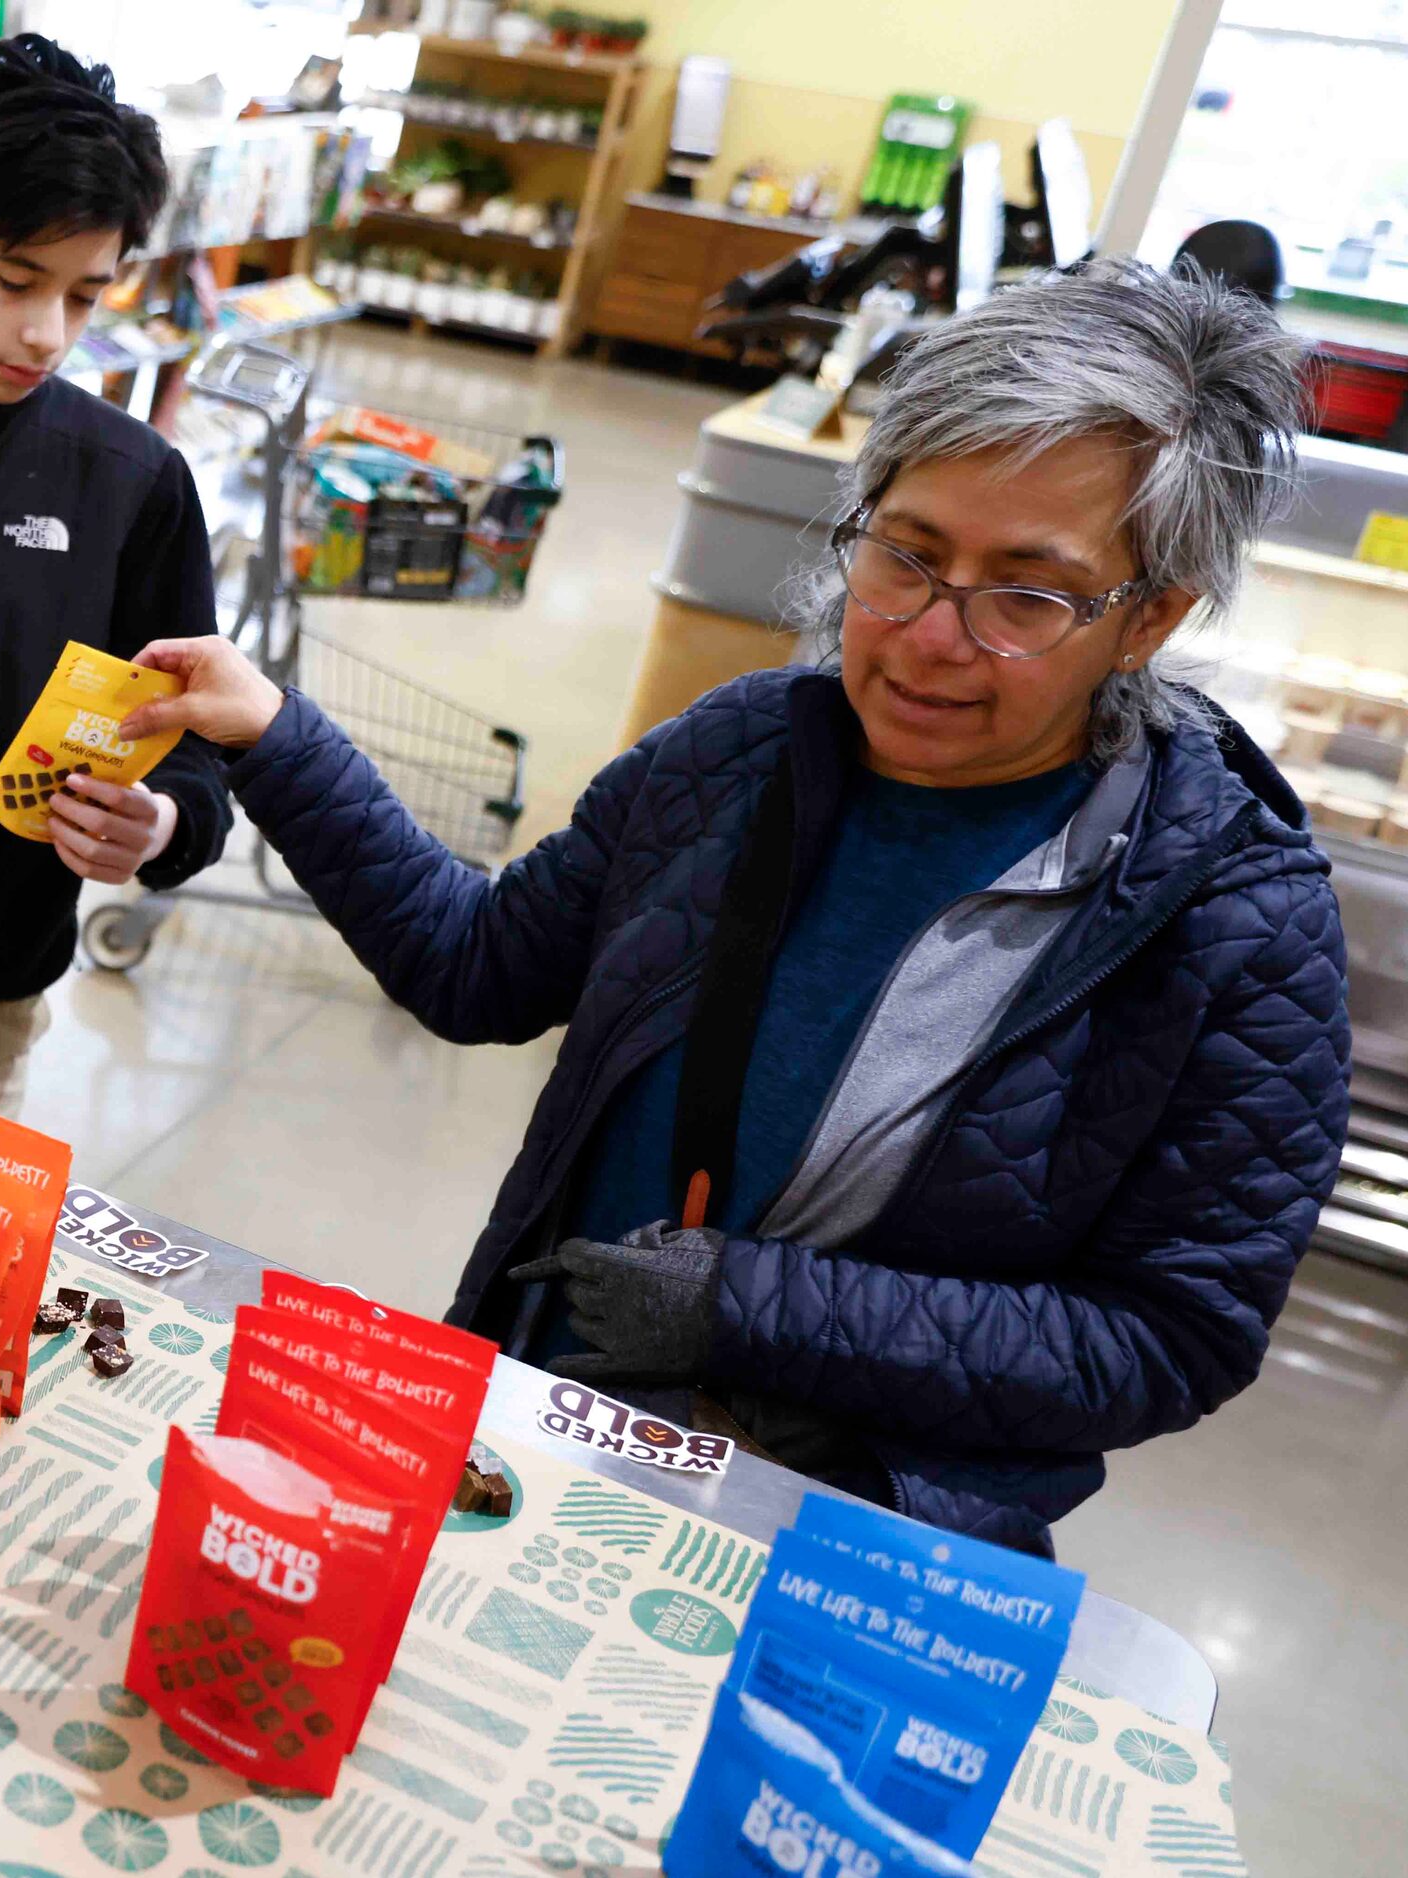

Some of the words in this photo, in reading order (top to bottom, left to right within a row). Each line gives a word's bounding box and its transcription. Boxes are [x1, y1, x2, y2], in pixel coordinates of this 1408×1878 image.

[3, 523, 48, 540] NORTH
[15, 536, 48, 549] FACE
[23, 514, 49, 529] THE
[58, 740, 86, 757] VEGAN
[64, 721, 135, 757] BOLD
[75, 707, 121, 737] WICK
[58, 1209, 168, 1275] WICKE
[64, 1188, 205, 1268] BOLD
[275, 1292, 310, 1316] LIVE
[311, 1304, 344, 1329] LIFE
[347, 1314, 365, 1334] TO
[286, 1340, 318, 1366] LIFE
[323, 1351, 341, 1372] TO
[343, 1360, 374, 1385] THE
[375, 1369, 457, 1412] BOLDEST!
[247, 1360, 280, 1392] LIVE
[280, 1378, 311, 1410] LIFE
[313, 1394, 330, 1417] TO
[332, 1405, 359, 1434] THE
[358, 1421, 430, 1479] BOLDEST!
[544, 1412, 721, 1472] WICKED
[549, 1382, 730, 1461] BOLD
[200, 1522, 319, 1604] BOLD
[210, 1502, 322, 1574] WICKED
[652, 1594, 693, 1639] WHOLE
[673, 1604, 712, 1649] FOODS
[777, 1568, 823, 1607] LIVE
[821, 1589, 866, 1626] LIFE
[866, 1605, 890, 1633] TO
[893, 1615, 930, 1651] THE
[928, 1632, 1028, 1694] BOLDEST!
[960, 1579, 1054, 1630] BOLDEST!
[894, 1730, 984, 1785] BOLD
[906, 1714, 989, 1765] WICKED
[759, 1778, 882, 1878] WICKED
